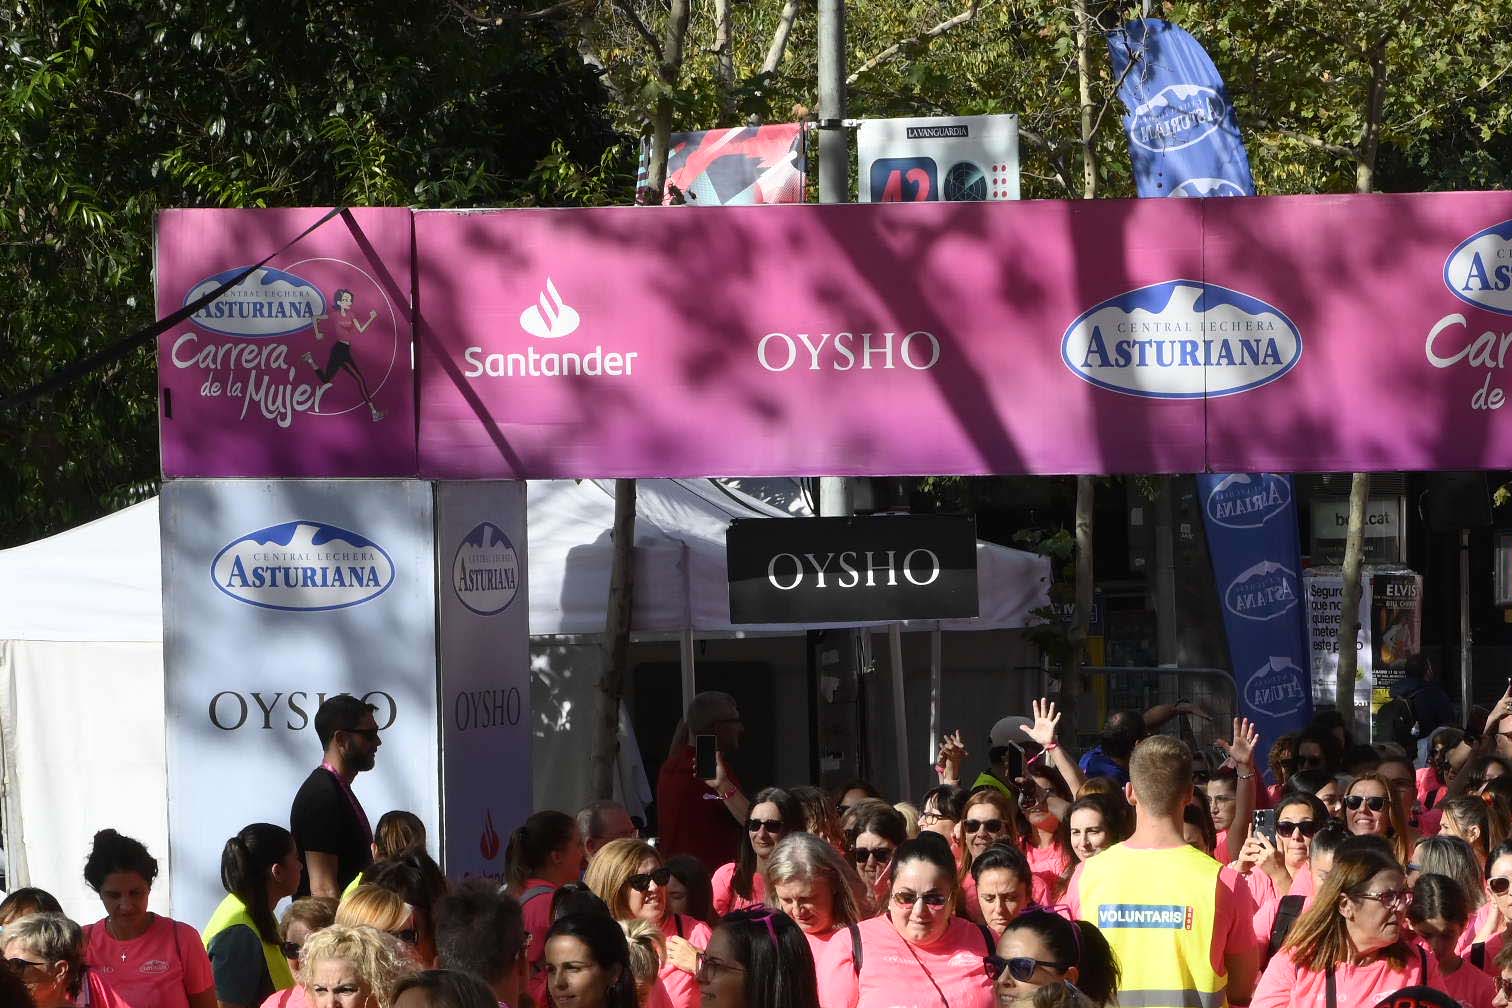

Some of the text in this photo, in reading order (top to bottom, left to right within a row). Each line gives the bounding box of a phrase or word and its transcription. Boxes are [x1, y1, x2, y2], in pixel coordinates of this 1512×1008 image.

[195, 293, 316, 319] ASTURIANA
[1117, 320, 1275, 334] CENTRAL LECHERA
[171, 332, 289, 370] Carrera
[464, 346, 638, 378] Santander
[757, 331, 941, 372] OYSHO
[1081, 325, 1283, 368] ASTURIANA
[201, 367, 333, 428] de la Mujer
[1471, 371, 1505, 410] de
[227, 555, 381, 588] ASTURIANA
[253, 552, 375, 561] CENTRAL LECHERA
[458, 557, 516, 592] ASTURIANA
[767, 548, 941, 591] OYSHO
[1313, 639, 1333, 651] este
[208, 690, 397, 731] OYSO
[455, 687, 521, 732] OYSHO
[1099, 909, 1183, 924] VOLUNTARIS
